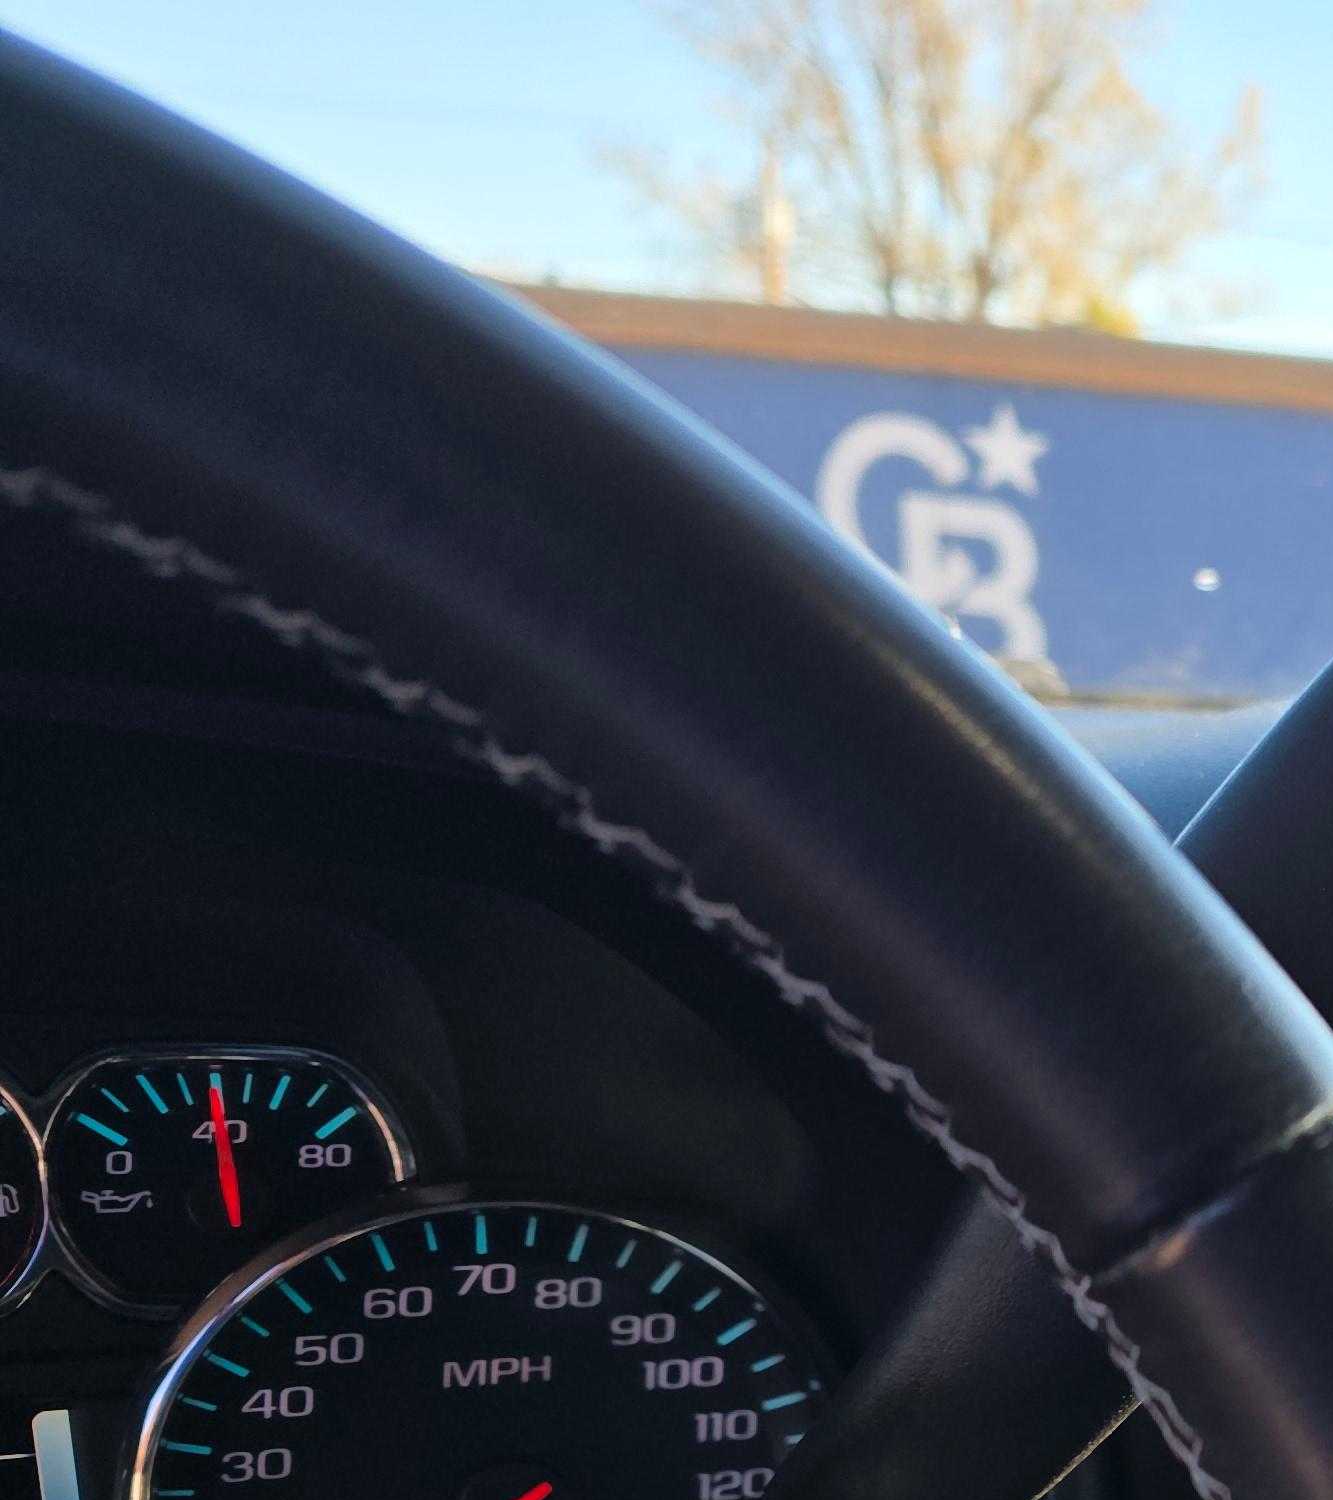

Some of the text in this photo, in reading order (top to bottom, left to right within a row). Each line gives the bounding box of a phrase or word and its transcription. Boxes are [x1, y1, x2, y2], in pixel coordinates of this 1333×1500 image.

[192, 1119, 248, 1145] 40
[106, 1151, 133, 1175] 0
[299, 1144, 352, 1168] 80
[452, 1263, 517, 1297] 70
[534, 1277, 603, 1310] 80
[363, 1286, 433, 1319] 60
[609, 1313, 676, 1346] 90
[295, 1333, 365, 1366] 50
[442, 1355, 551, 1389] MPH
[643, 1356, 725, 1391] 100
[241, 1385, 315, 1419] 40
[694, 1409, 759, 1444] 110
[220, 1448, 293, 1483] 30
